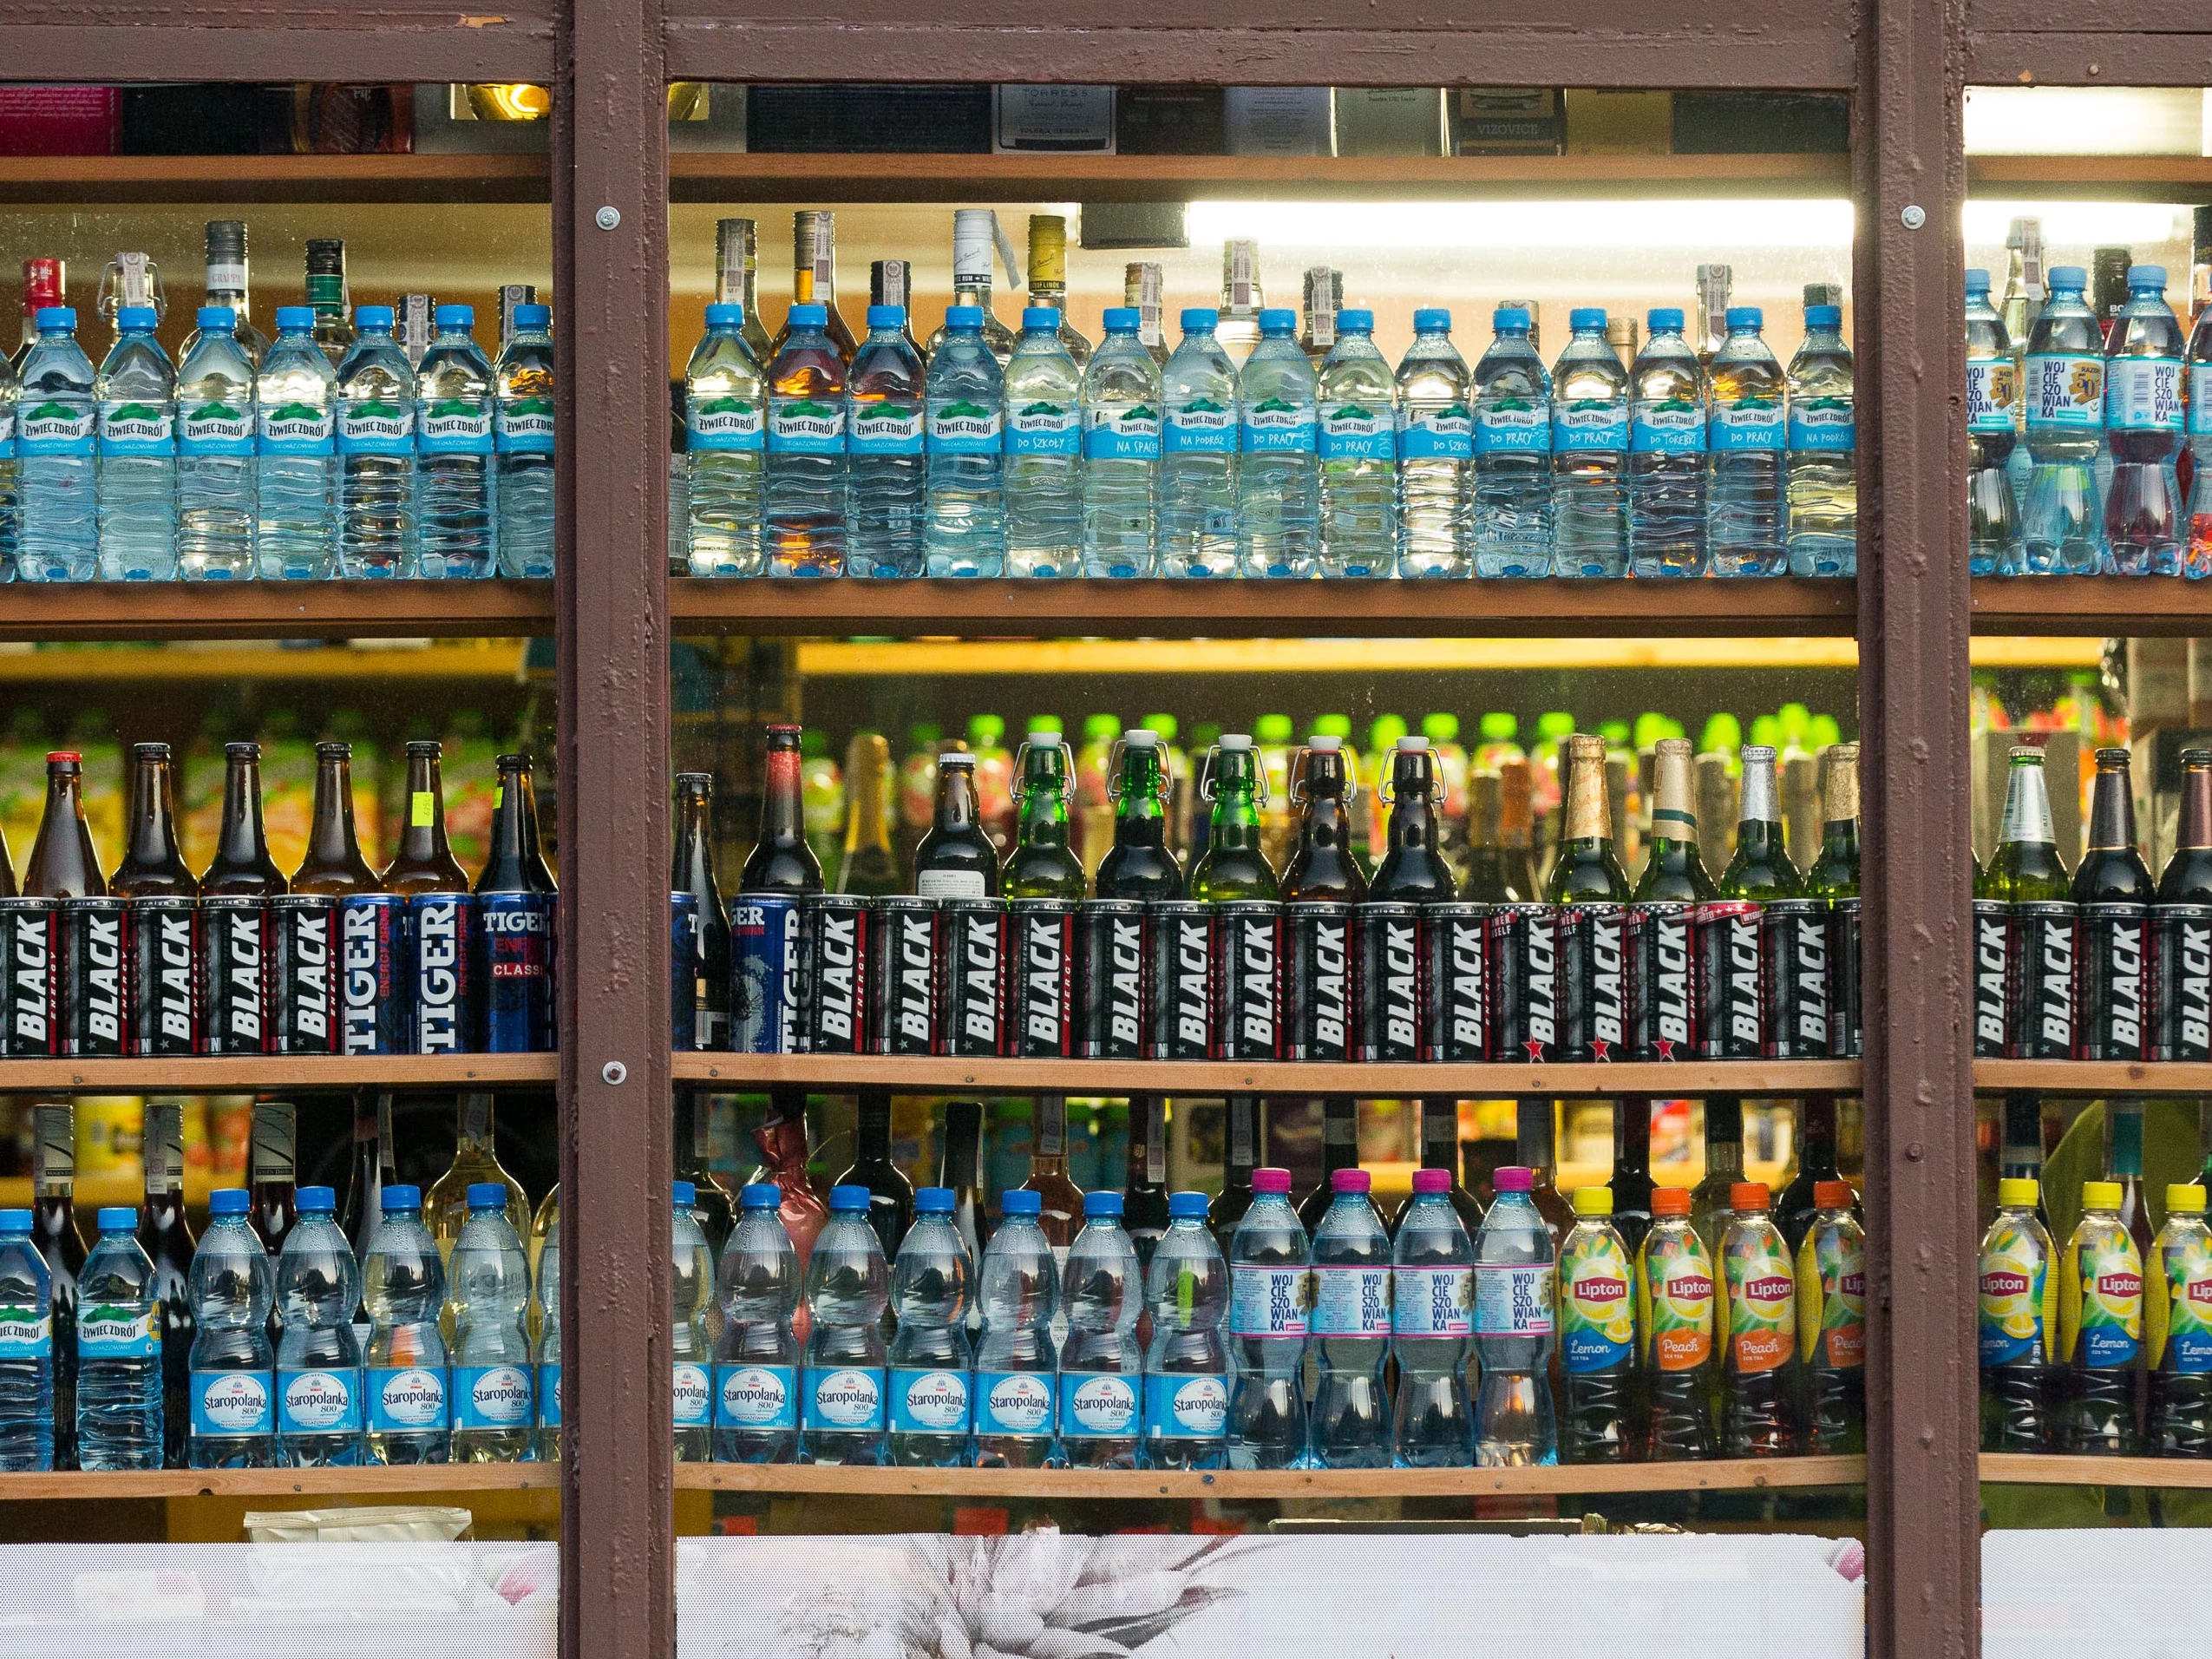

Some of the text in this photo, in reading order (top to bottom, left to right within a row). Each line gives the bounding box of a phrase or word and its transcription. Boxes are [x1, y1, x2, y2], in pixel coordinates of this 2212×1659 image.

[1022, 89, 1077, 98] TORRES
[1477, 124, 1539, 134] VIZOVICE
[212, 273, 241, 283] GRAPPA
[2044, 361, 2065, 373] WOJ
[2155, 365, 2175, 377] WOJ
[2043, 371, 2058, 384] CIE
[2155, 377, 2169, 389] CIE
[2042, 384, 2061, 396] SZO
[2155, 389, 2172, 400] SZO
[2042, 395, 2070, 408] WIAN
[2155, 399, 2179, 411] WIAN
[1731, 413, 1773, 423] ŻYWIEC ZDRÓJ
[1807, 413, 1849, 423] ŻYWIEC ZDRÓJ
[2041, 406, 2054, 418] KA
[2155, 410, 2168, 422] KA
[507, 419, 534, 433] ŻYWIEC
[699, 416, 754, 430] ŻYWIEC ZDRÓJ
[1020, 418, 1063, 430] ŻYWIEC ZDRÓJ
[1181, 416, 1224, 426] ŻYWIEC ZDRÓJ
[1253, 415, 1296, 425] ŻYWIEC ZDRÓJ
[1436, 422, 1457, 431] ŻYWIEC
[1490, 416, 1512, 425] ŻYWIEC
[1569, 416, 1590, 425] ŻYWIEC
[1652, 415, 1695, 425] ŻYWIEC ZDRÓJ
[26, 423, 80, 436] ŻYWIEC ZDRÓJ
[108, 423, 162, 437] ŻYWIEC ZDRÓJ
[187, 423, 242, 436] ŻYWIEC ZDRÓJ
[269, 423, 323, 436] ŻYWIEC ZDRÓJ
[347, 422, 402, 436] ŻYWIEC ZDRÓJ
[428, 420, 482, 434] ŻYWIEC ZDRÓJ
[779, 421, 833, 434] ŻYWIEC ZDRÓJ
[857, 422, 911, 435] ŻYWIEC ZDRÓJ
[937, 422, 991, 434] ŻYWIEC ZDRÓJ
[1121, 423, 1142, 433] ŻYWIEC
[1331, 423, 1373, 432] ŻYWIEC ZDRÓJ
[1018, 437, 1064, 449] DO SZKOŁY
[1181, 436, 1192, 445] NA
[1253, 435, 1265, 444] DO
[1490, 434, 1502, 443] DO
[1570, 433, 1580, 443] DO
[1650, 434, 1696, 444] DO TOREBKI
[1731, 432, 1772, 443] DO PRACY
[1807, 434, 1817, 443] NA
[1117, 441, 1158, 454] NA SPACE
[1331, 441, 1372, 453] DO PRACY
[1433, 441, 1445, 450] DO
[380, 904, 390, 999] ENERGY DRINK
[16, 914, 46, 1041] BLACK
[89, 914, 118, 1041] BLACK
[162, 913, 190, 1041] BLACK
[232, 913, 259, 1039] BLACK
[297, 912, 326, 1039] BLACK
[344, 904, 376, 1056] TIGER
[421, 902, 456, 1055] TIGER
[822, 913, 854, 1039] BLACK
[901, 915, 931, 1041] BLACK
[966, 916, 997, 1043] BLACK
[1029, 917, 1060, 1044] BLACK
[1112, 918, 1140, 1045] BLACK
[1528, 919, 1554, 1045] BLACK
[1594, 919, 1621, 1045] BLACK
[1659, 918, 1687, 1045] BLACK
[1731, 918, 1759, 1044] BLACK
[1798, 918, 1827, 1043] BLACK
[1979, 918, 2006, 1045] BLACK
[857, 950, 866, 1019] ENERGY
[1179, 919, 1207, 1046] BLACK
[1244, 920, 1273, 1046] BLACK
[1317, 921, 1345, 1046] BLACK
[1388, 921, 1415, 1048] BLACK
[1454, 921, 1482, 1048] BLACK
[2044, 920, 2071, 1046] BLACK
[2112, 921, 2141, 1048] BLACK
[2183, 923, 2211, 1048] BLACK
[1271, 1274, 1293, 1286] WOJ
[1363, 1274, 1382, 1286] WOJ
[1432, 1274, 1454, 1286] WOJ
[1513, 1273, 1535, 1285] WOJ
[2102, 1277, 2141, 1292] Lipton
[1271, 1286, 1286, 1297] CIE
[1363, 1285, 1377, 1297] CIE
[1432, 1285, 1448, 1297] CIE
[1513, 1284, 1528, 1296] CIE
[1579, 1282, 1623, 1298] Lipton
[1672, 1282, 1711, 1296] Lipton
[1751, 1282, 1790, 1297] Lipton
[1271, 1297, 1290, 1308] SZO
[1363, 1297, 1379, 1308] SZO
[1432, 1297, 1451, 1308] SZO
[1513, 1296, 1533, 1307] SZO
[1271, 1308, 1298, 1320] WIAN
[1363, 1308, 1386, 1320] WIAN
[1432, 1308, 1460, 1320] WIAN
[1513, 1307, 1541, 1319] WIAN
[1271, 1320, 1285, 1331] KA
[1363, 1319, 1375, 1331] KA
[1432, 1319, 1447, 1331] KA
[1513, 1318, 1528, 1330] KA
[14, 1326, 39, 1339] ZDRÓJ
[83, 1325, 135, 1338] ŻYWIEC ZDRÓJ
[1570, 1340, 1611, 1354] Lemon
[1662, 1338, 1698, 1352] Peach
[1741, 1338, 1779, 1354] Peach
[2091, 1334, 2129, 1348] Lemon
[204, 1393, 266, 1410] Staropolanka
[286, 1391, 348, 1407] Staropolanka
[383, 1388, 443, 1406] Staropolanka
[723, 1387, 785, 1403] Staropolanka
[817, 1388, 878, 1405] Staropolanka
[907, 1392, 966, 1407] Staropolanka
[990, 1395, 1050, 1410] Staropolanka
[1074, 1395, 1135, 1412] Staropolanka
